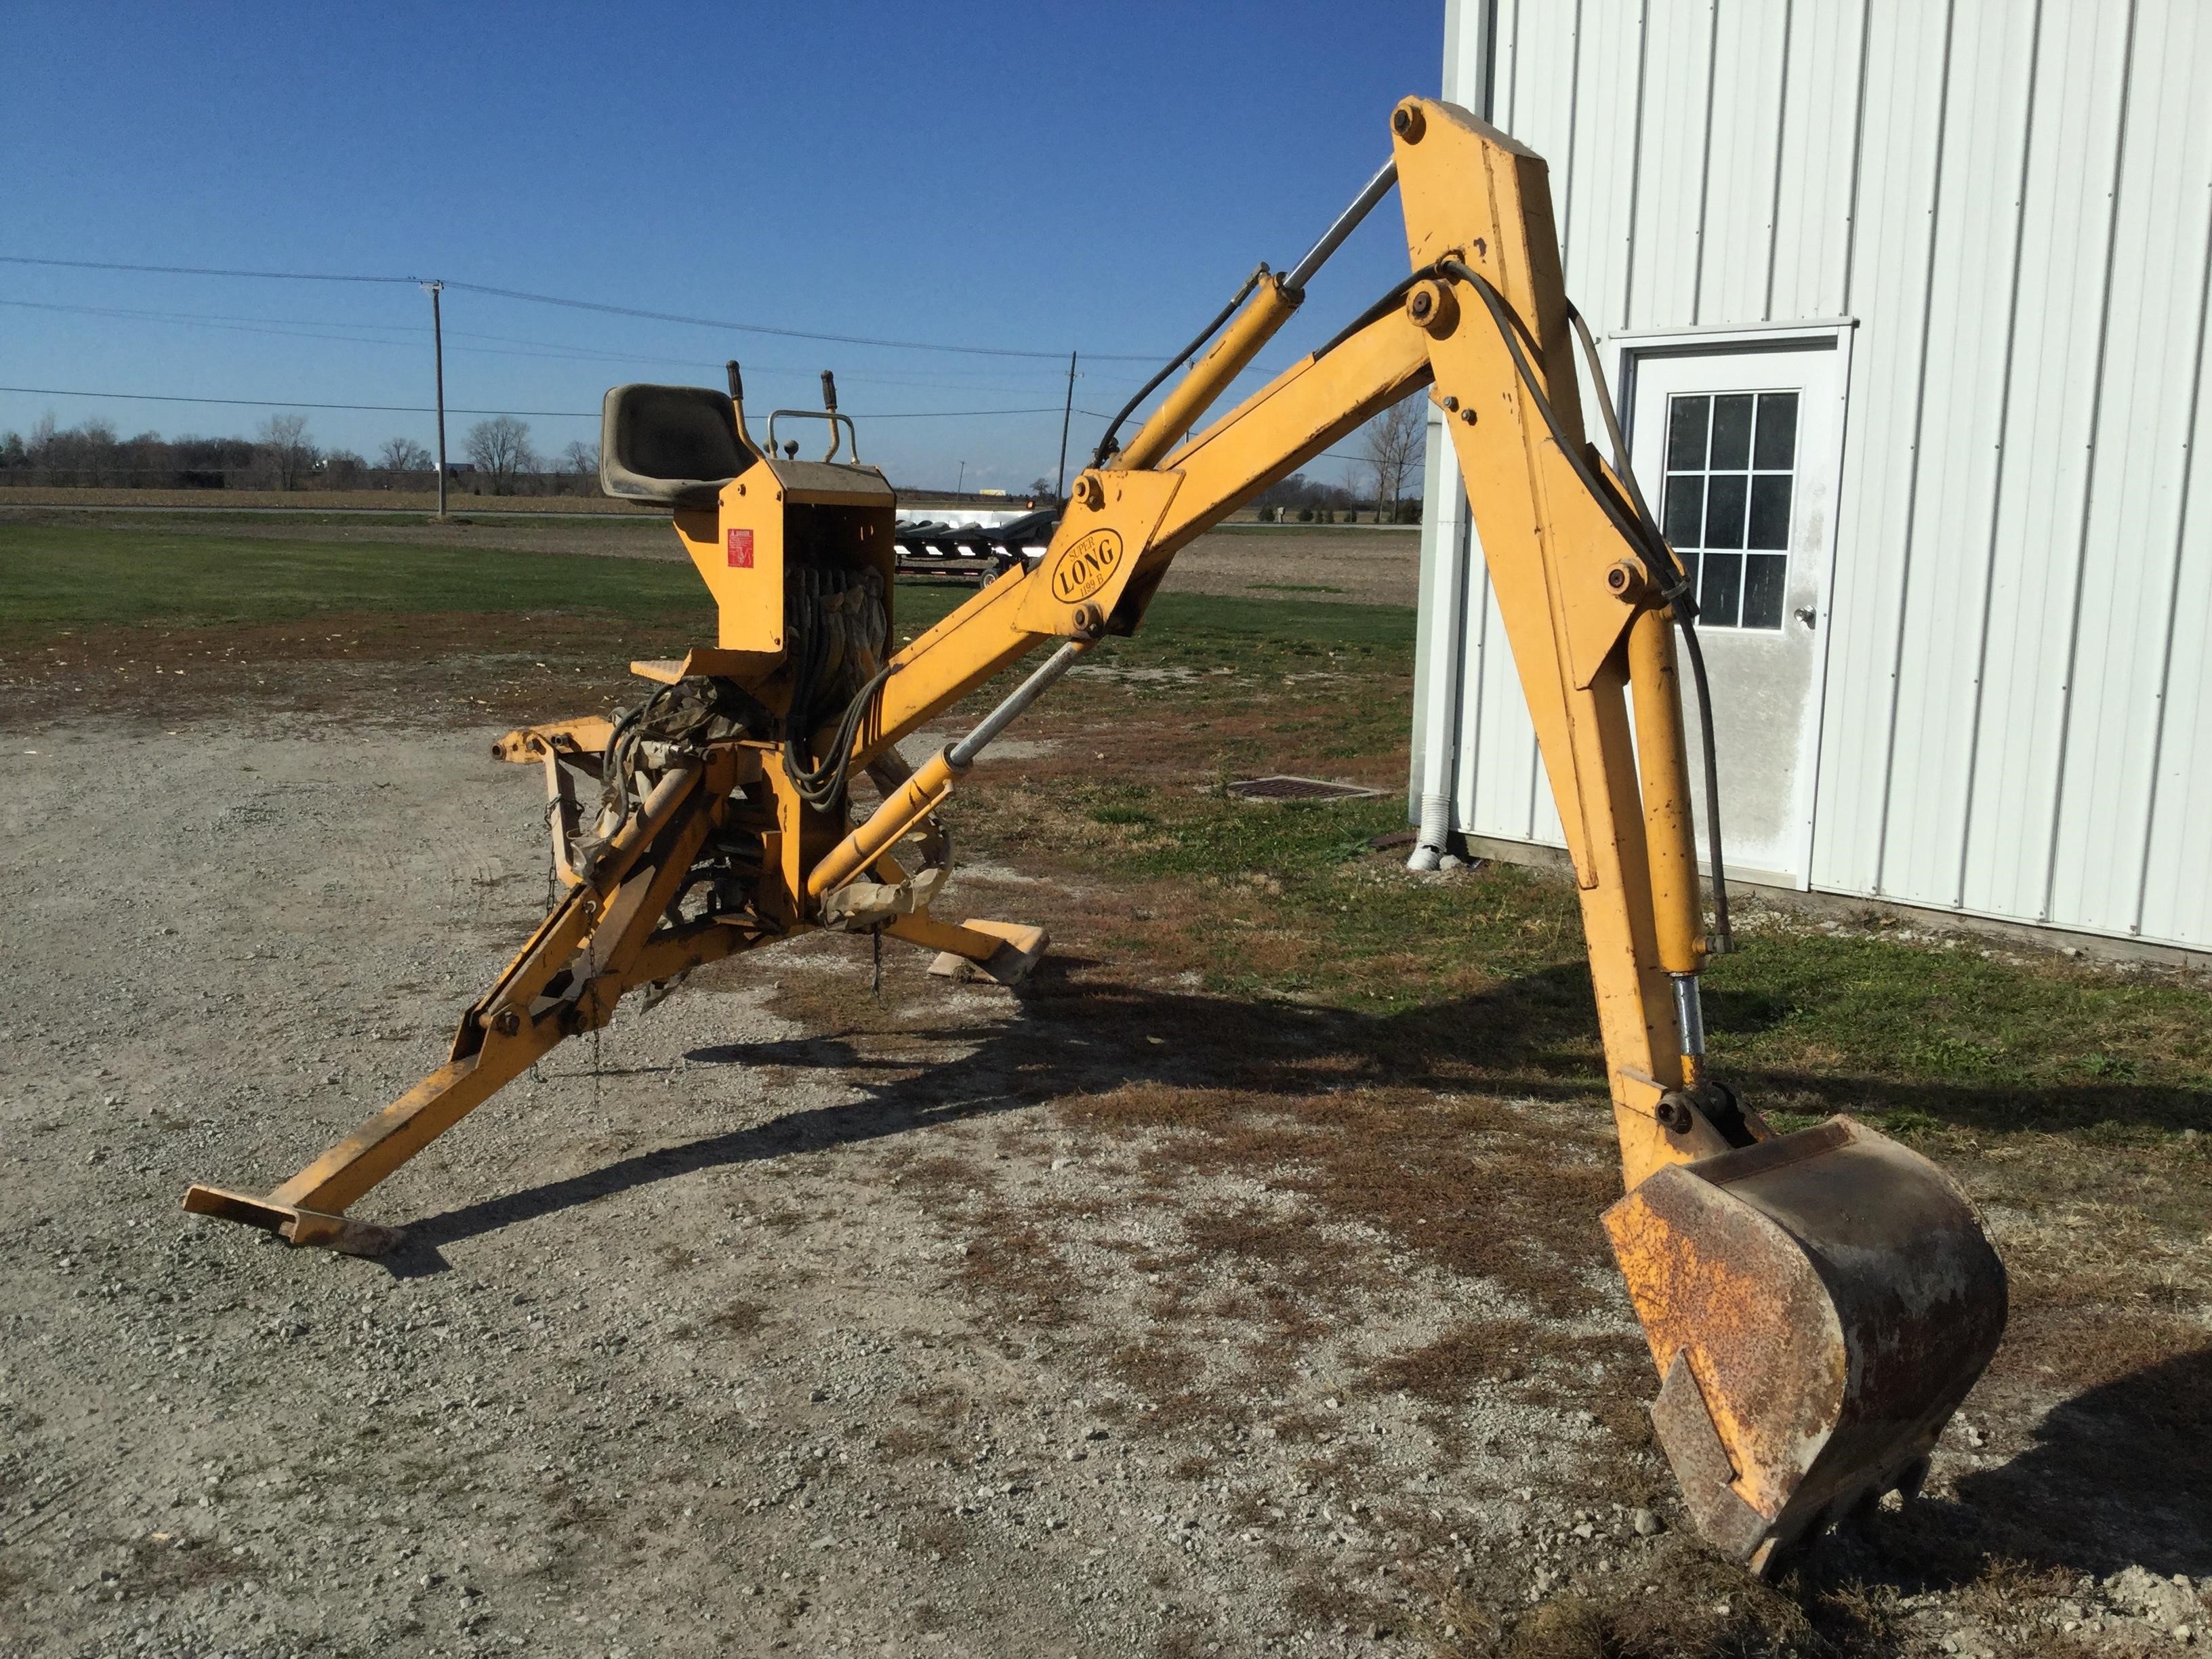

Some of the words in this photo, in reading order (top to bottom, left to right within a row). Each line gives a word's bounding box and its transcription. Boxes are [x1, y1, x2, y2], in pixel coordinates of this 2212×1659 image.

[1069, 537, 1094, 561] SUPER
[1060, 539, 1113, 596] LONG
[1080, 579, 1096, 597] 1199
[1097, 573, 1104, 585] B
